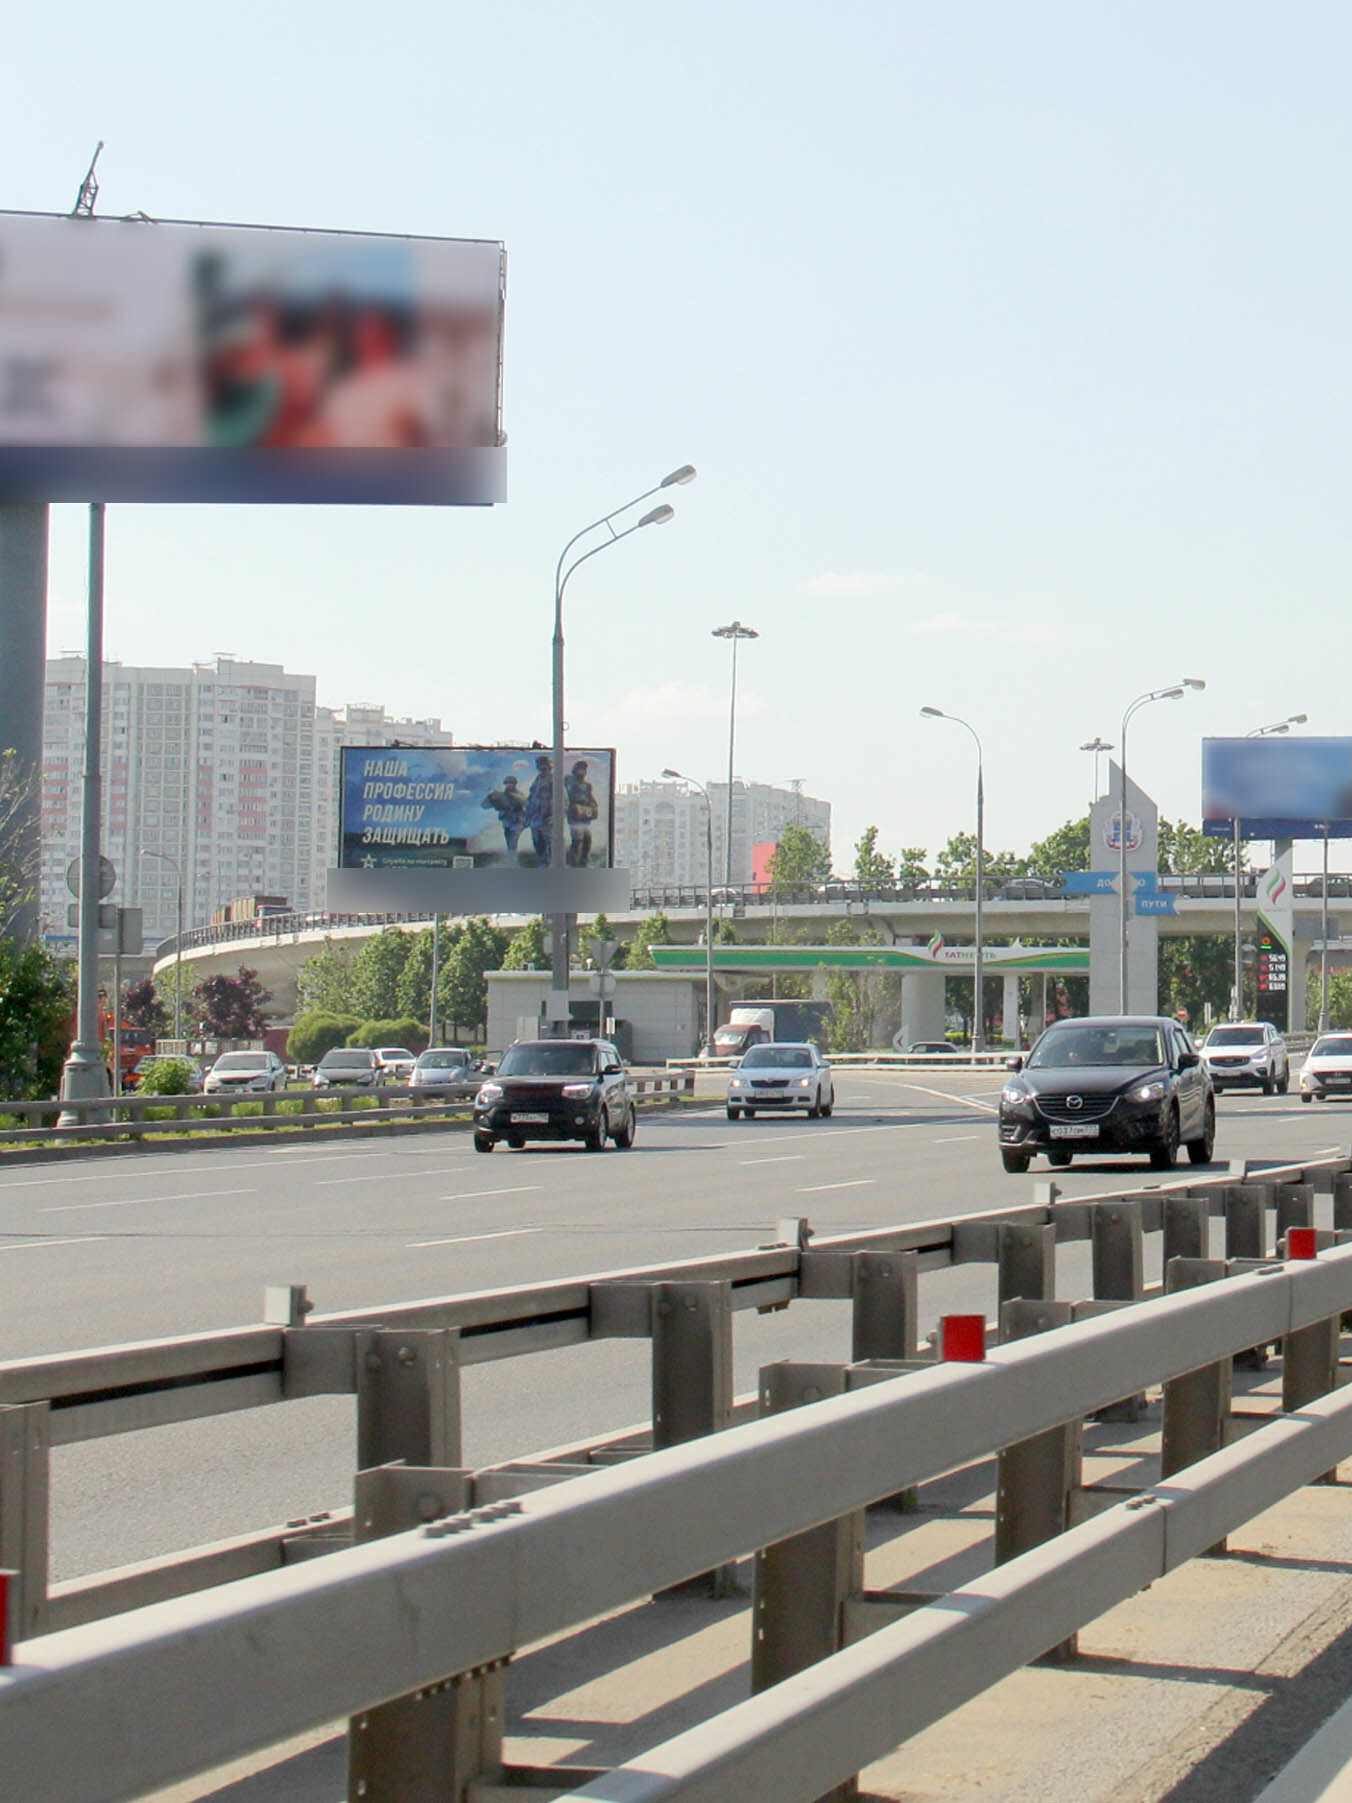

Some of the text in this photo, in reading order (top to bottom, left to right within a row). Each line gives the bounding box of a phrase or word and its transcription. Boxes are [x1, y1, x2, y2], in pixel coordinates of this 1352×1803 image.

[363, 760, 408, 776] НАША
[363, 782, 454, 800] ПРОФЕССИЯ
[362, 805, 424, 823] РОДИНУ
[362, 827, 449, 847] ЗАЩИЩАТЬ
[1096, 879, 1145, 888] ДОО
[1141, 900, 1168, 909] ПУТИ
[944, 951, 997, 959] ТАТНЕТЬ
